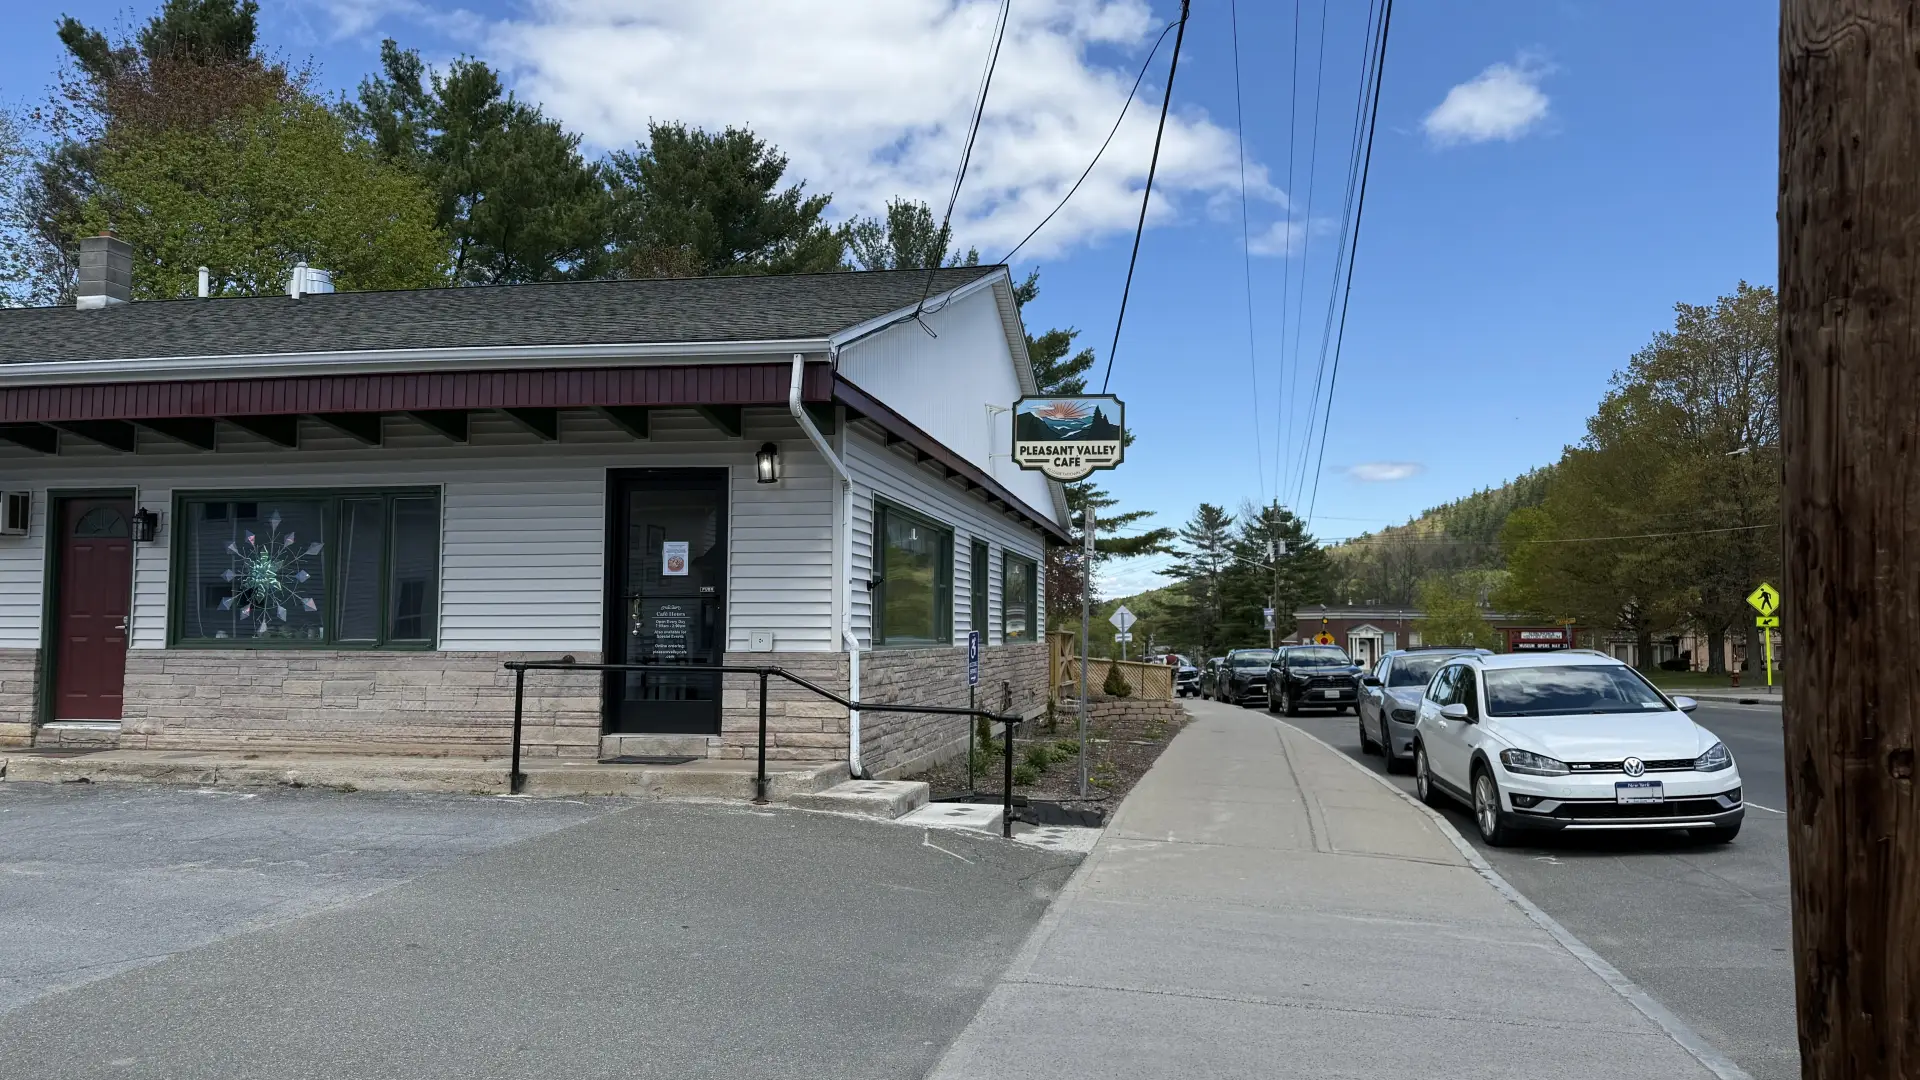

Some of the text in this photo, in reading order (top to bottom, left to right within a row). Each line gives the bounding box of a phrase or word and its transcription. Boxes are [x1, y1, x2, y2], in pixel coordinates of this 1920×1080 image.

[1020, 446, 1116, 456] PLEASANT VALLEY
[1054, 455, 1080, 467] CAFÉ
